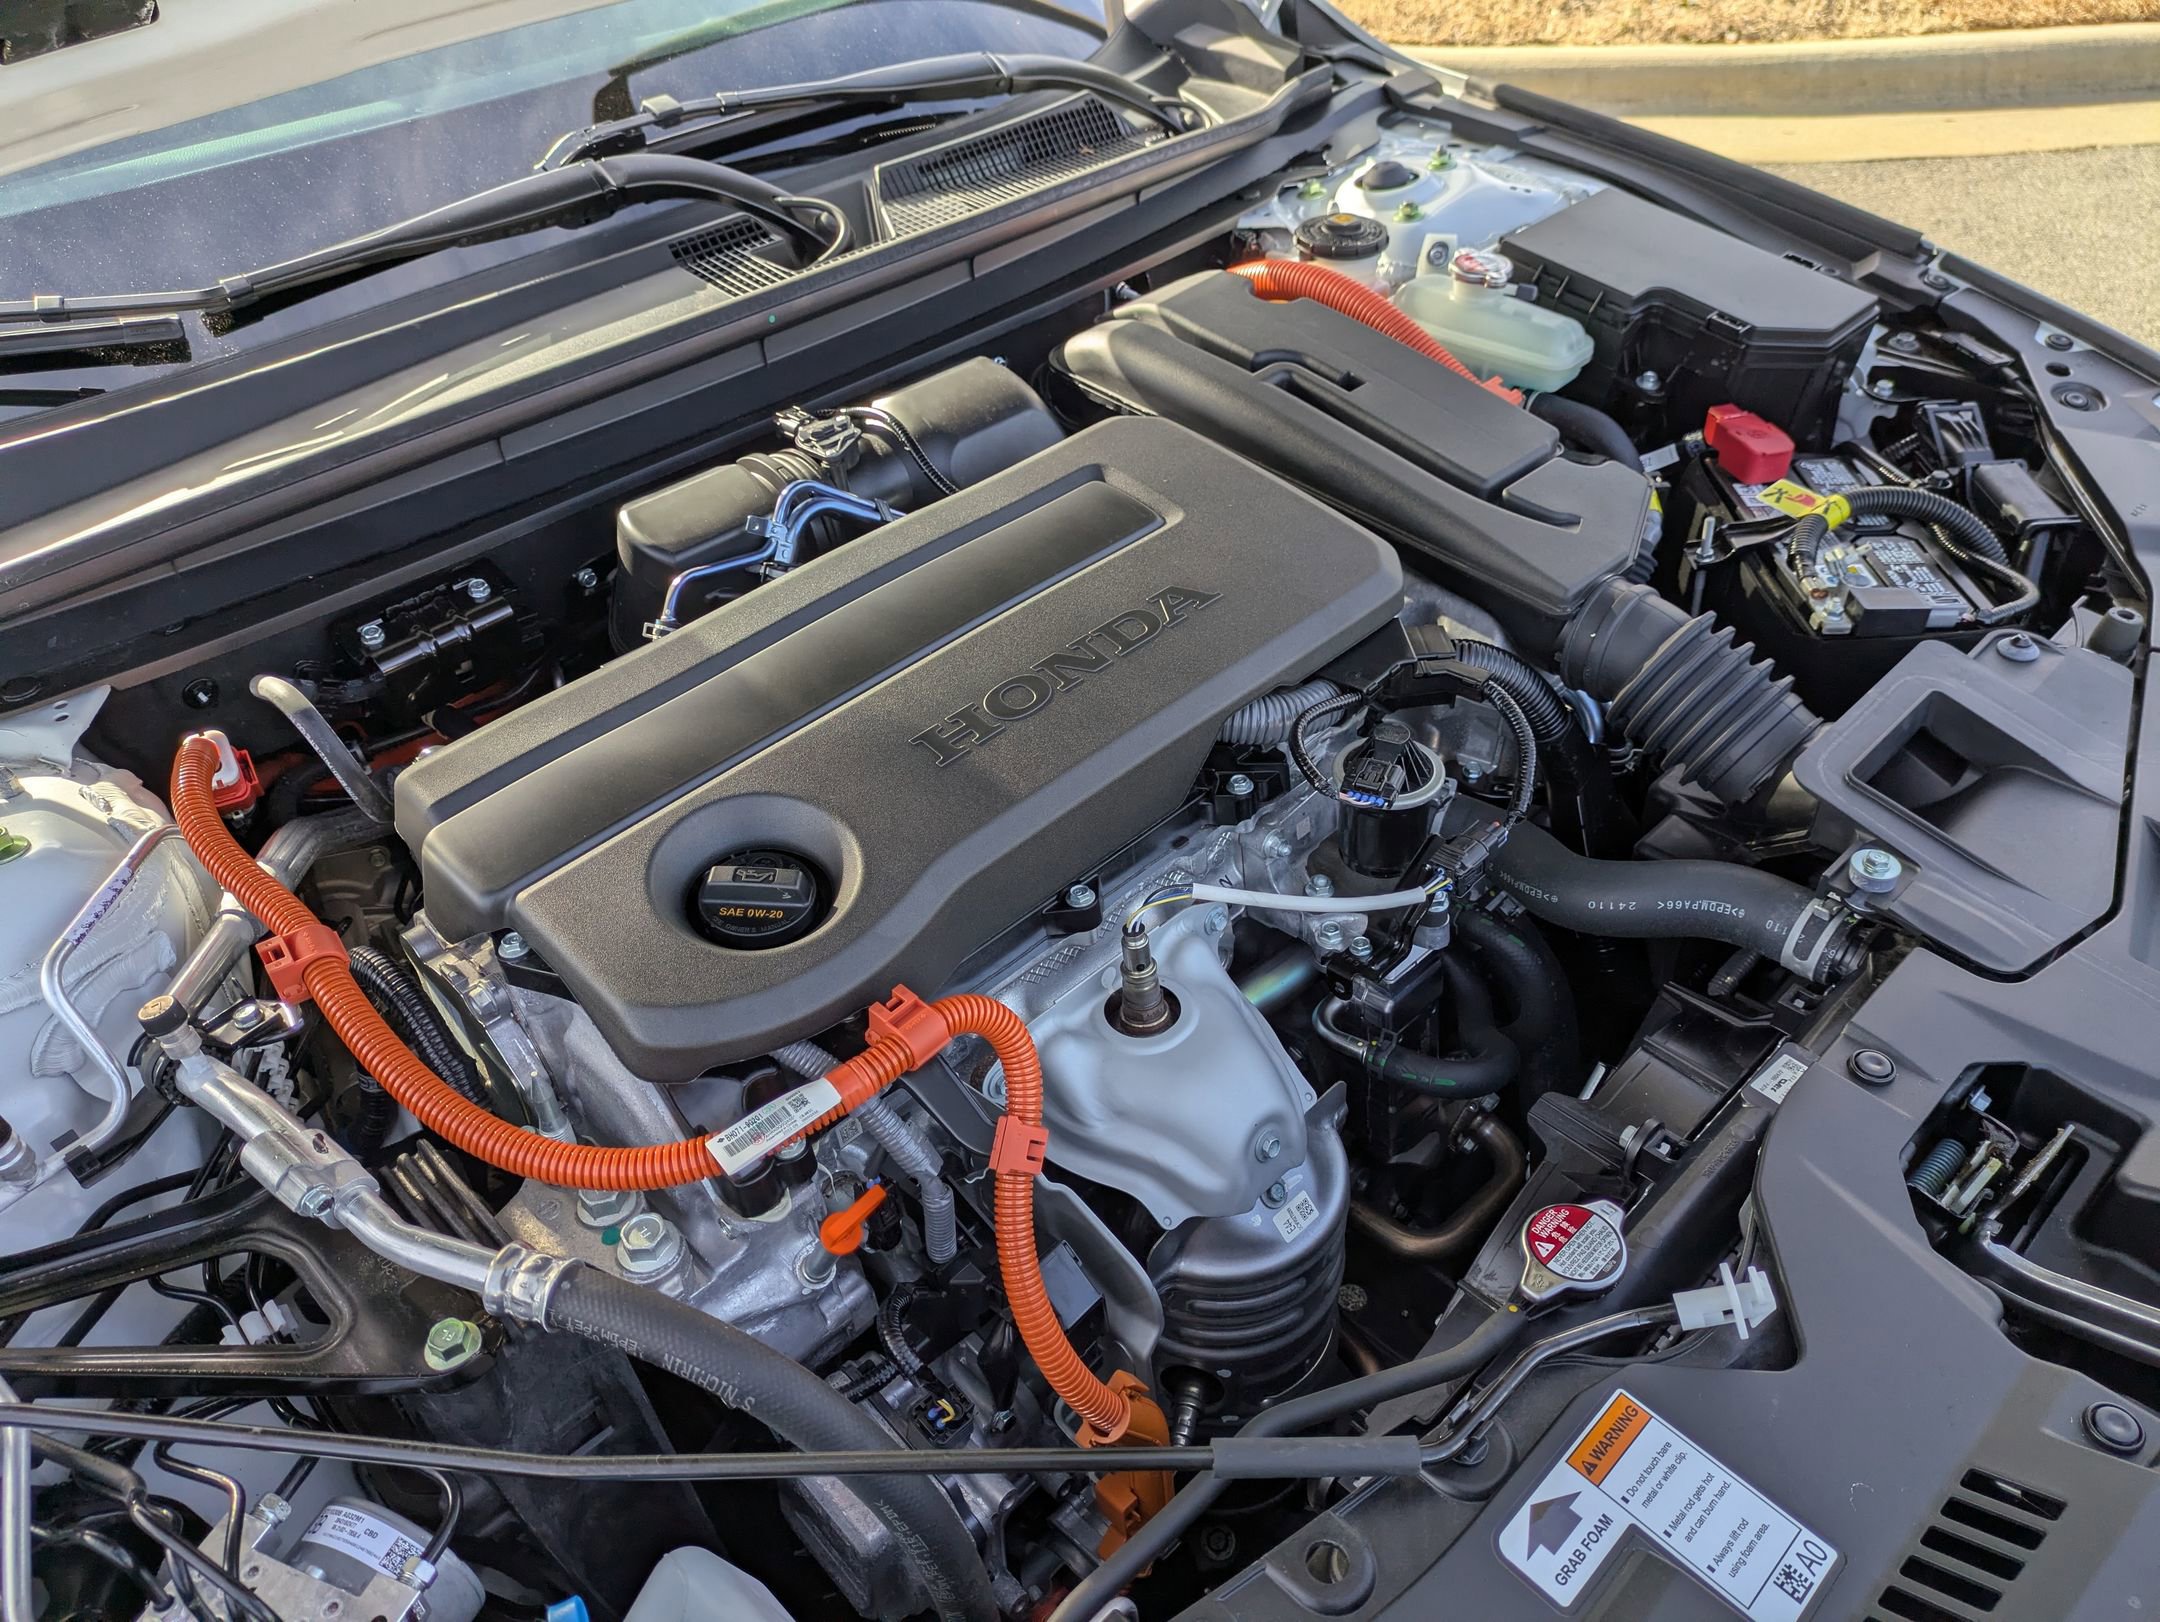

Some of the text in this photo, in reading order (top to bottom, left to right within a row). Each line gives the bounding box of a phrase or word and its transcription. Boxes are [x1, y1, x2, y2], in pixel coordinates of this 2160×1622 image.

[909, 585, 1224, 767] HONDA
[719, 906, 784, 919] SAE 0W-20
[1587, 900, 1636, 910] 24110
[1283, 1218, 1296, 1234] E44
[1531, 1207, 1556, 1234] DANGER
[1538, 1207, 1570, 1239] WARNUNG
[1588, 1403, 1640, 1463] WARNING
[1625, 1439, 1673, 1498] Do not touch bare
[1639, 1448, 1689, 1509] metal or white clip.
[1668, 1471, 1715, 1532] Metal rod gets hot
[1681, 1478, 1732, 1543] and can burn hand.
[363, 1527, 378, 1539] CBD
[1553, 1513, 1614, 1587] GRAB FOAM
[1710, 1517, 1750, 1567] Always lift rod
[1726, 1520, 1771, 1579] using foam area.
[1802, 1540, 1828, 1576] A0
